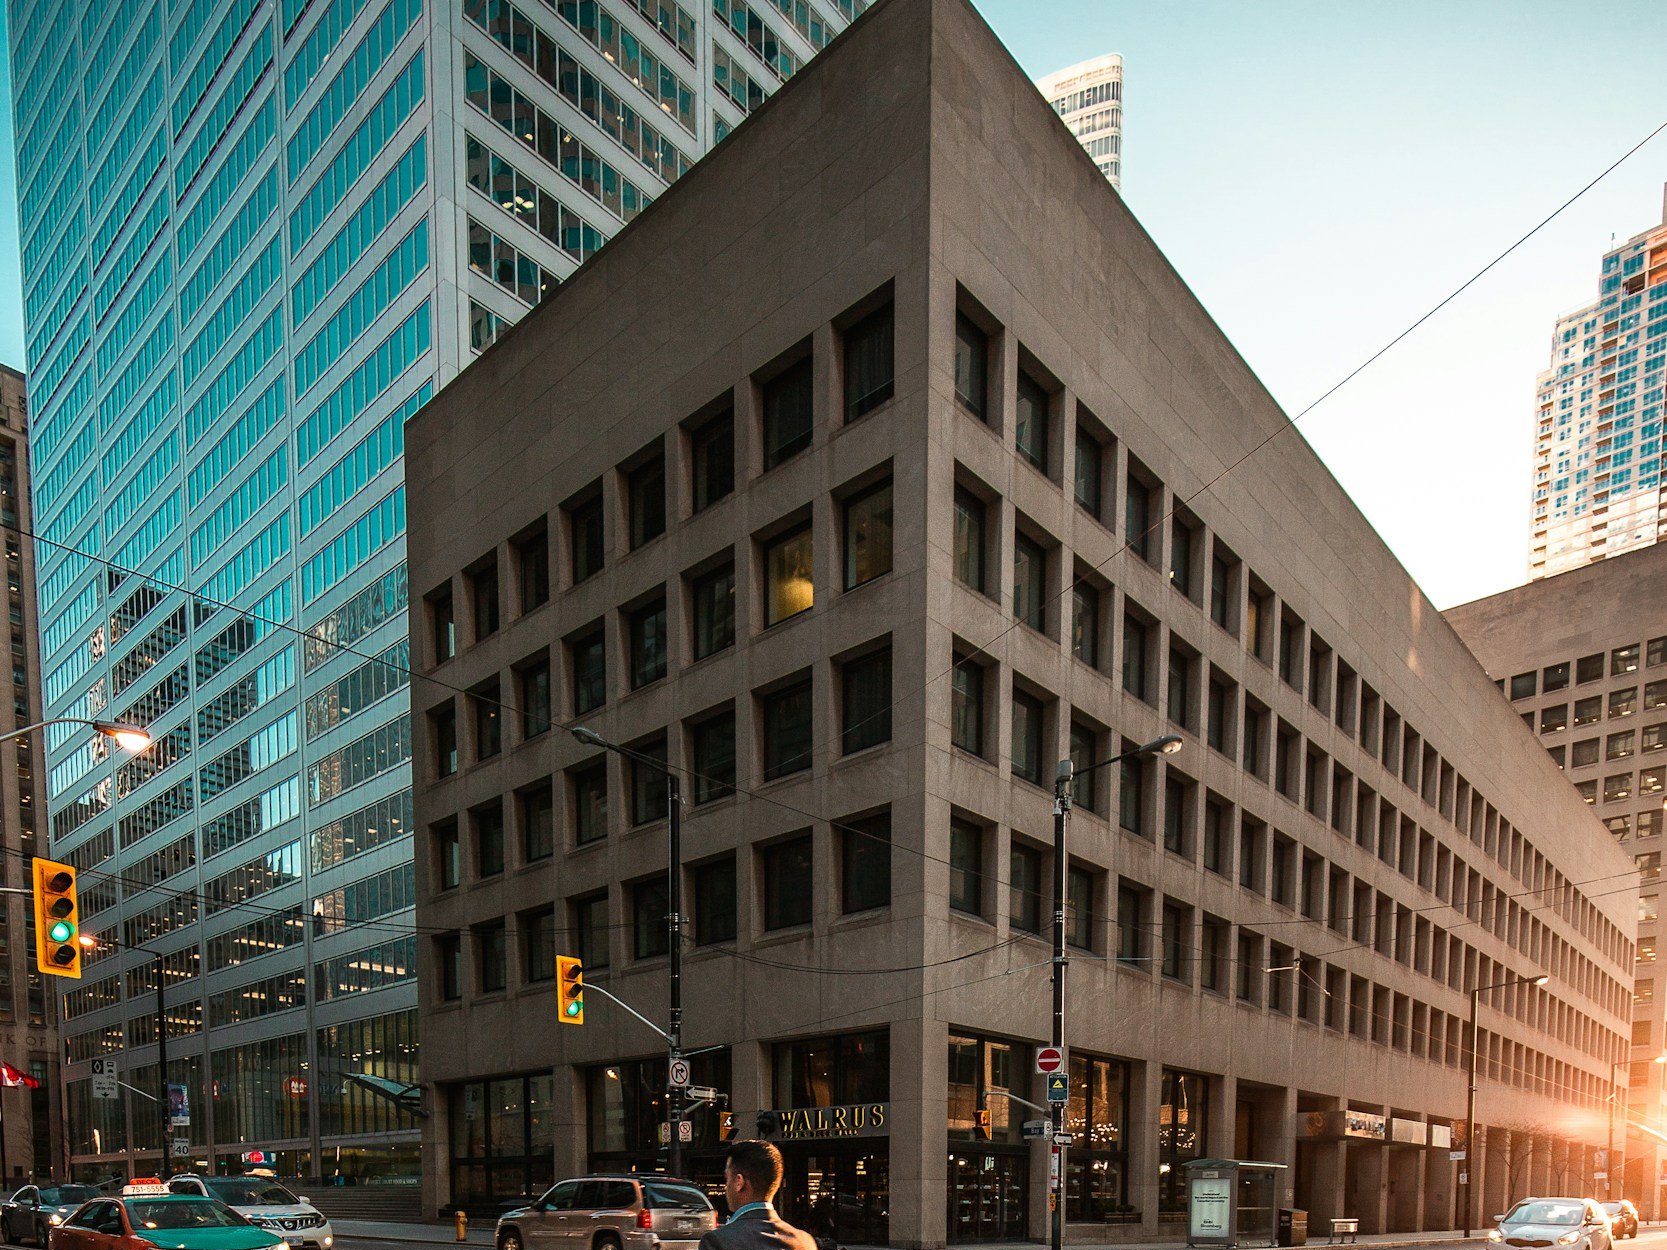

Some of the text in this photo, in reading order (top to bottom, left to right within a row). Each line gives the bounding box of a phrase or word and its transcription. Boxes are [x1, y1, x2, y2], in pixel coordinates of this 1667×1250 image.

[26, 1036, 46, 1047] OF
[780, 1105, 884, 1132] WALRUS
[1030, 1127, 1040, 1135] Bay
[175, 1145, 189, 1155] 40
[131, 1185, 165, 1193] 751-5555
